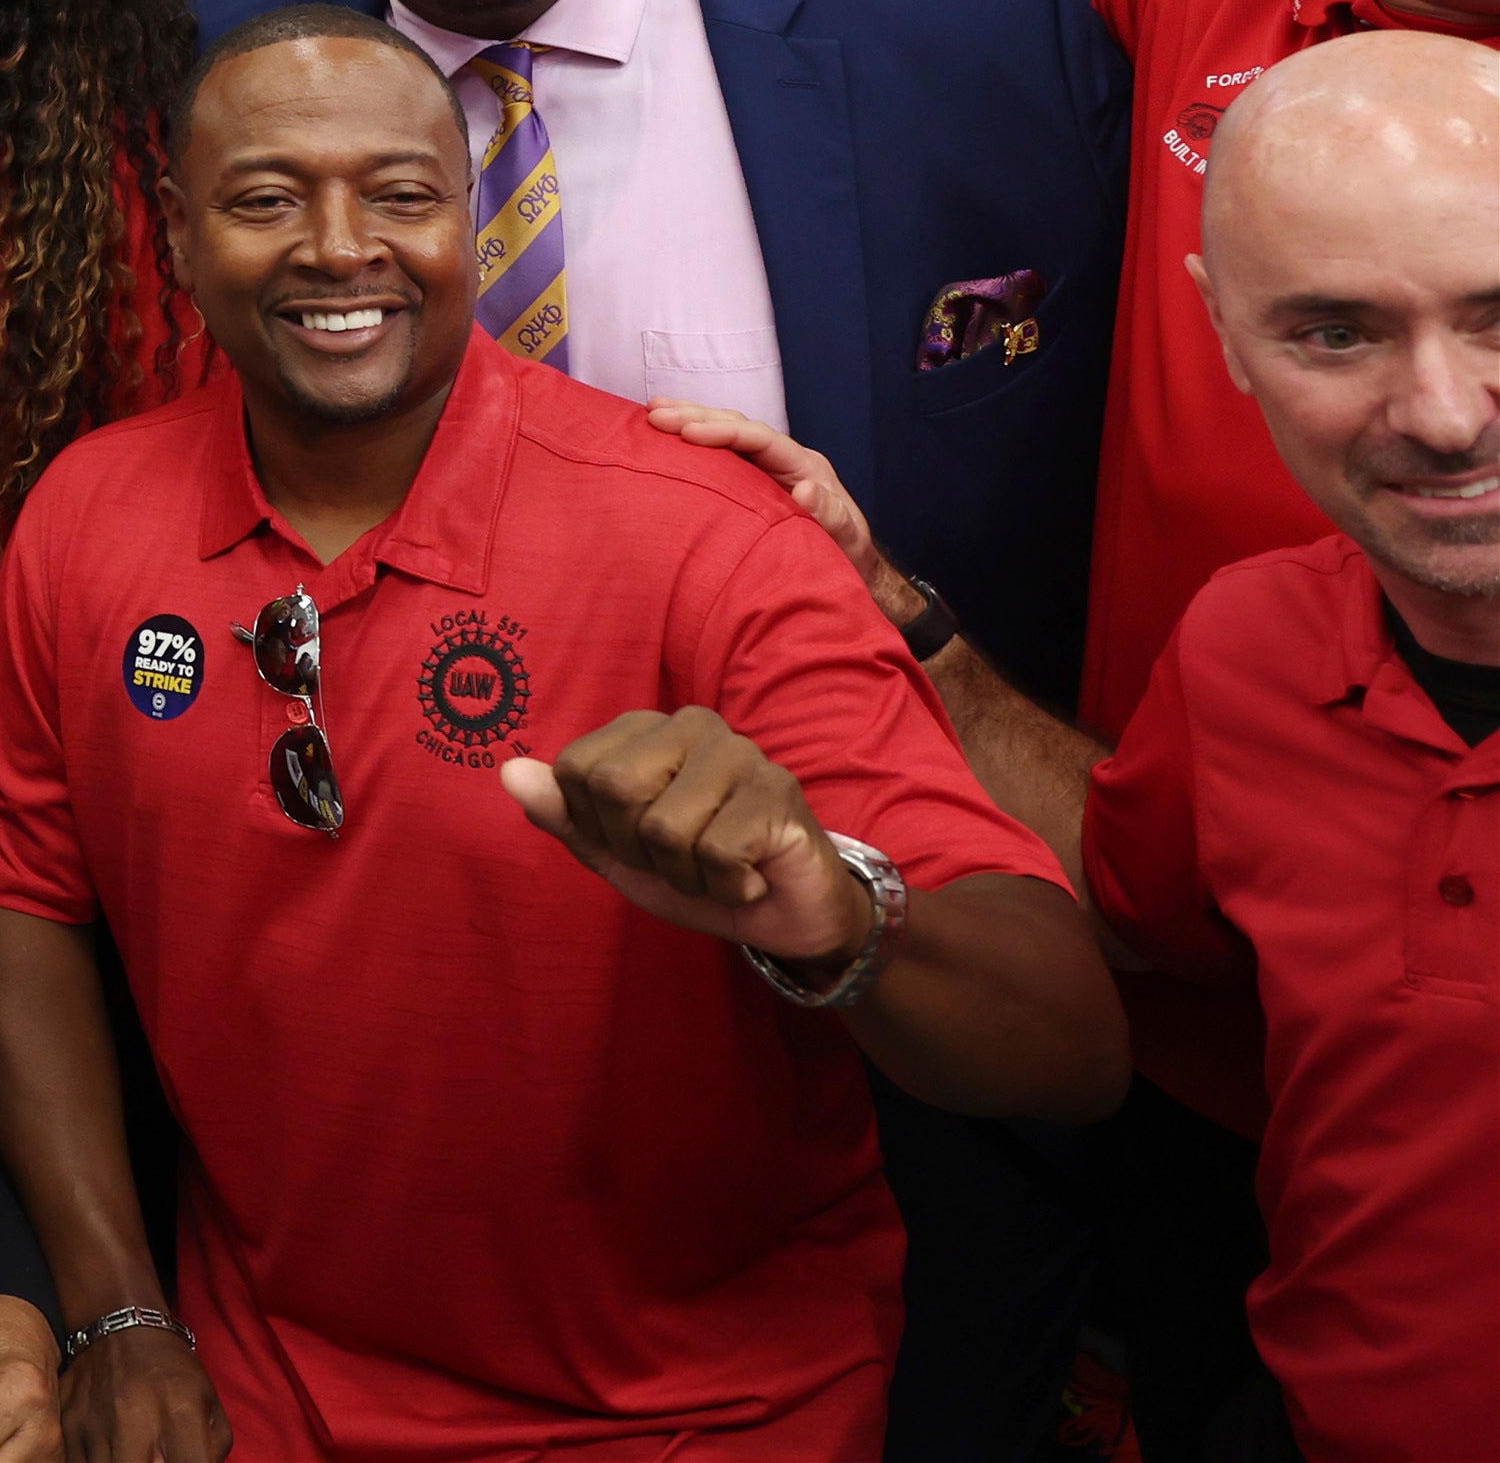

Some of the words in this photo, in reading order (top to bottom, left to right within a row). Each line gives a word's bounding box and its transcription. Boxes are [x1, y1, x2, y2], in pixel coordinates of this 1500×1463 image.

[1163, 129, 1199, 167] BUILT
[430, 609, 489, 637] LOCAL
[497, 615, 529, 642] 551
[138, 628, 197, 663] 97%
[132, 669, 193, 695] STRIKE
[134, 656, 176, 674] READY
[177, 664, 195, 678] TO
[450, 672, 498, 700] UAW
[415, 730, 497, 769] CHICAGO
[510, 740, 533, 758] IL
